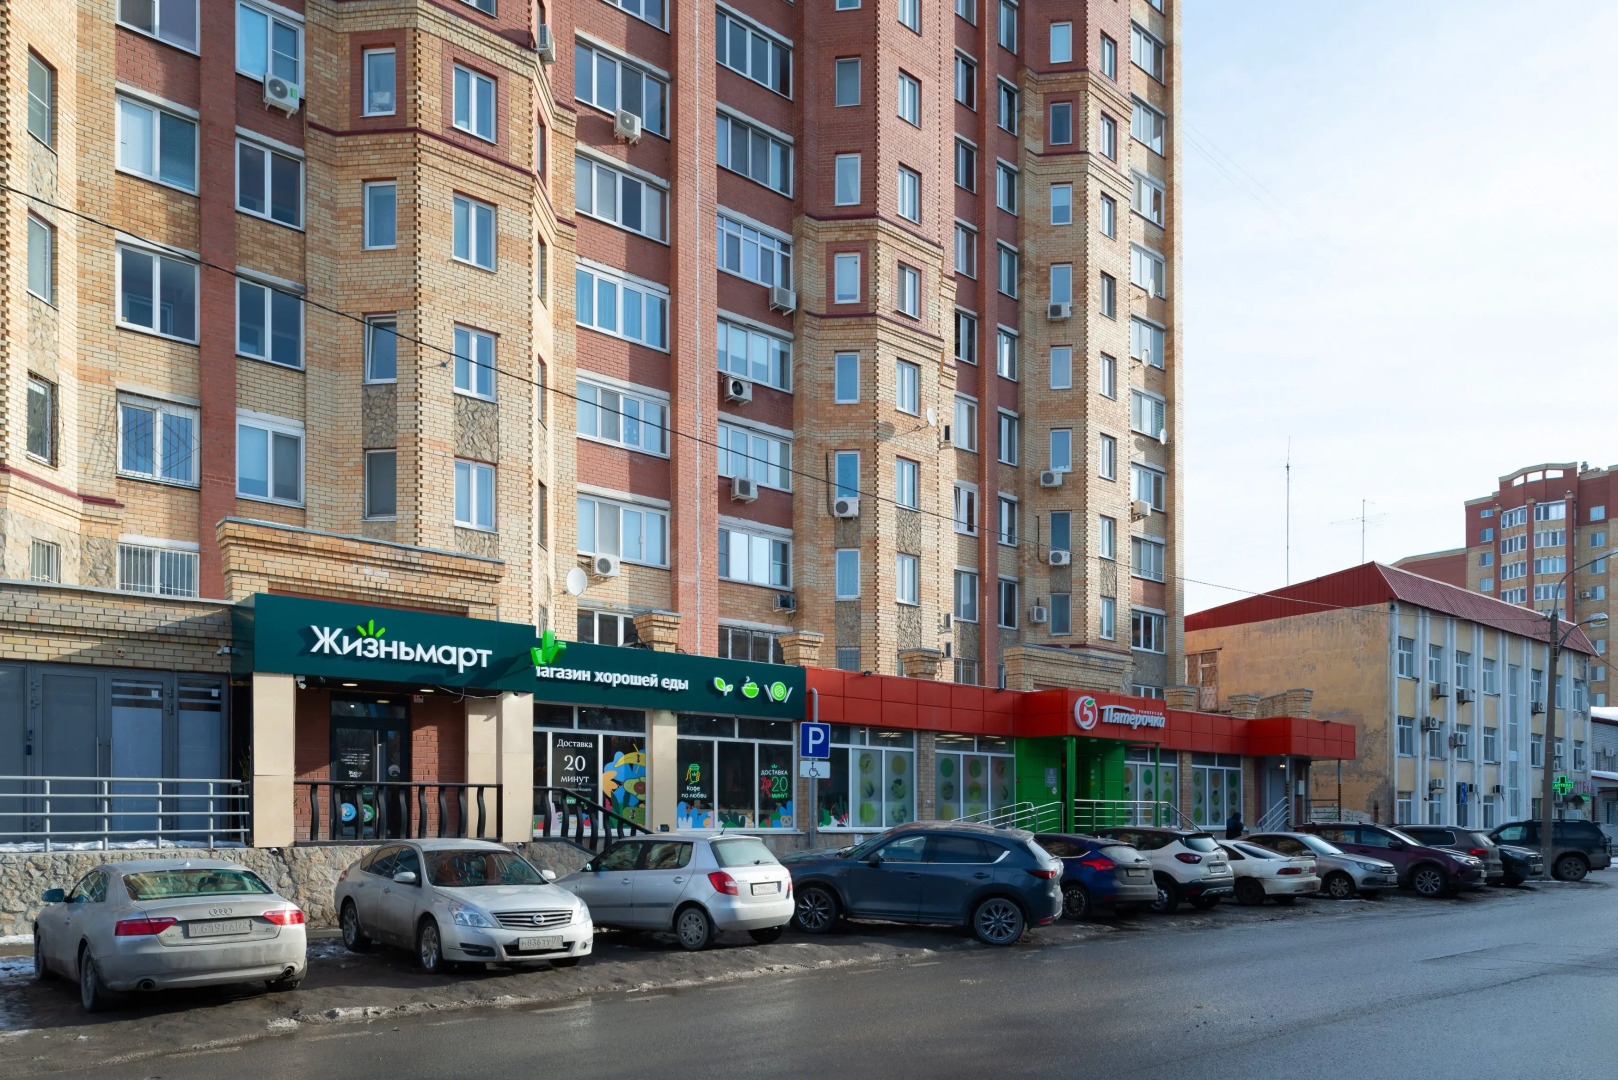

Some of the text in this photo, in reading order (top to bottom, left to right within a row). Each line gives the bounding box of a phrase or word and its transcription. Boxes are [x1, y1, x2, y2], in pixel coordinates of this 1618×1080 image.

[310, 625, 493, 673] Жизньмарт
[594, 671, 659, 687] хорошей
[661, 677, 689, 690] еды
[556, 739, 593, 748] Доставка
[808, 727, 825, 754] P
[563, 754, 586, 771] 20
[560, 776, 590, 785] минут
[771, 776, 789, 792] 20
